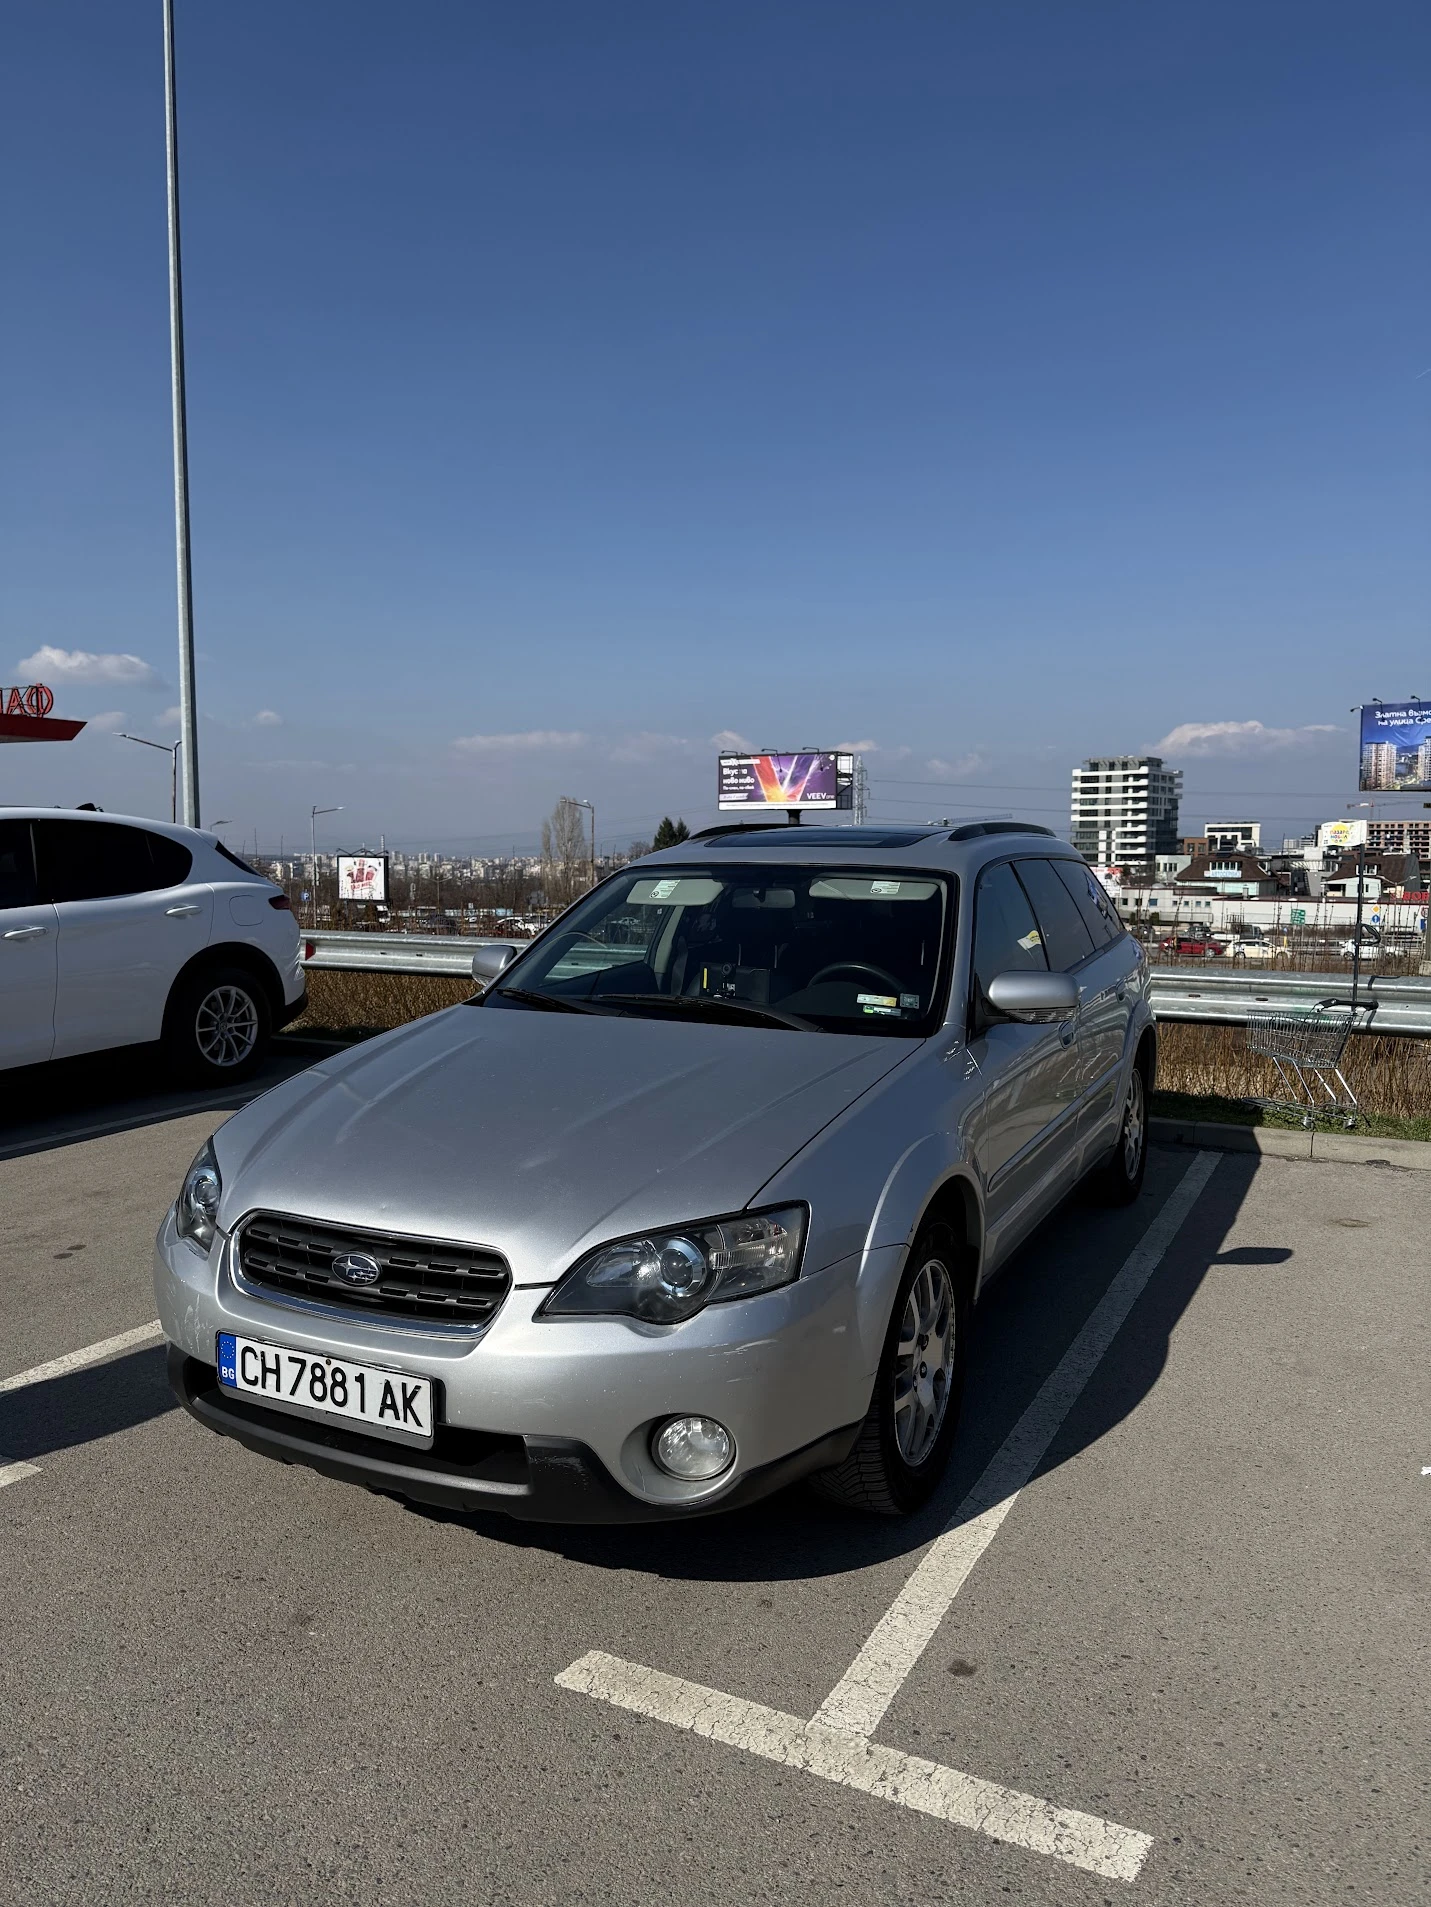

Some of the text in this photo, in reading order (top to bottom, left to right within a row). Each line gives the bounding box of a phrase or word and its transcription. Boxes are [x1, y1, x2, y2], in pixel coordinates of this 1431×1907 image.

[1375, 711, 1407, 719] Златна
[1389, 718, 1414, 727] улица
[806, 792, 827, 800] VEEV
[221, 1366, 235, 1380] BG
